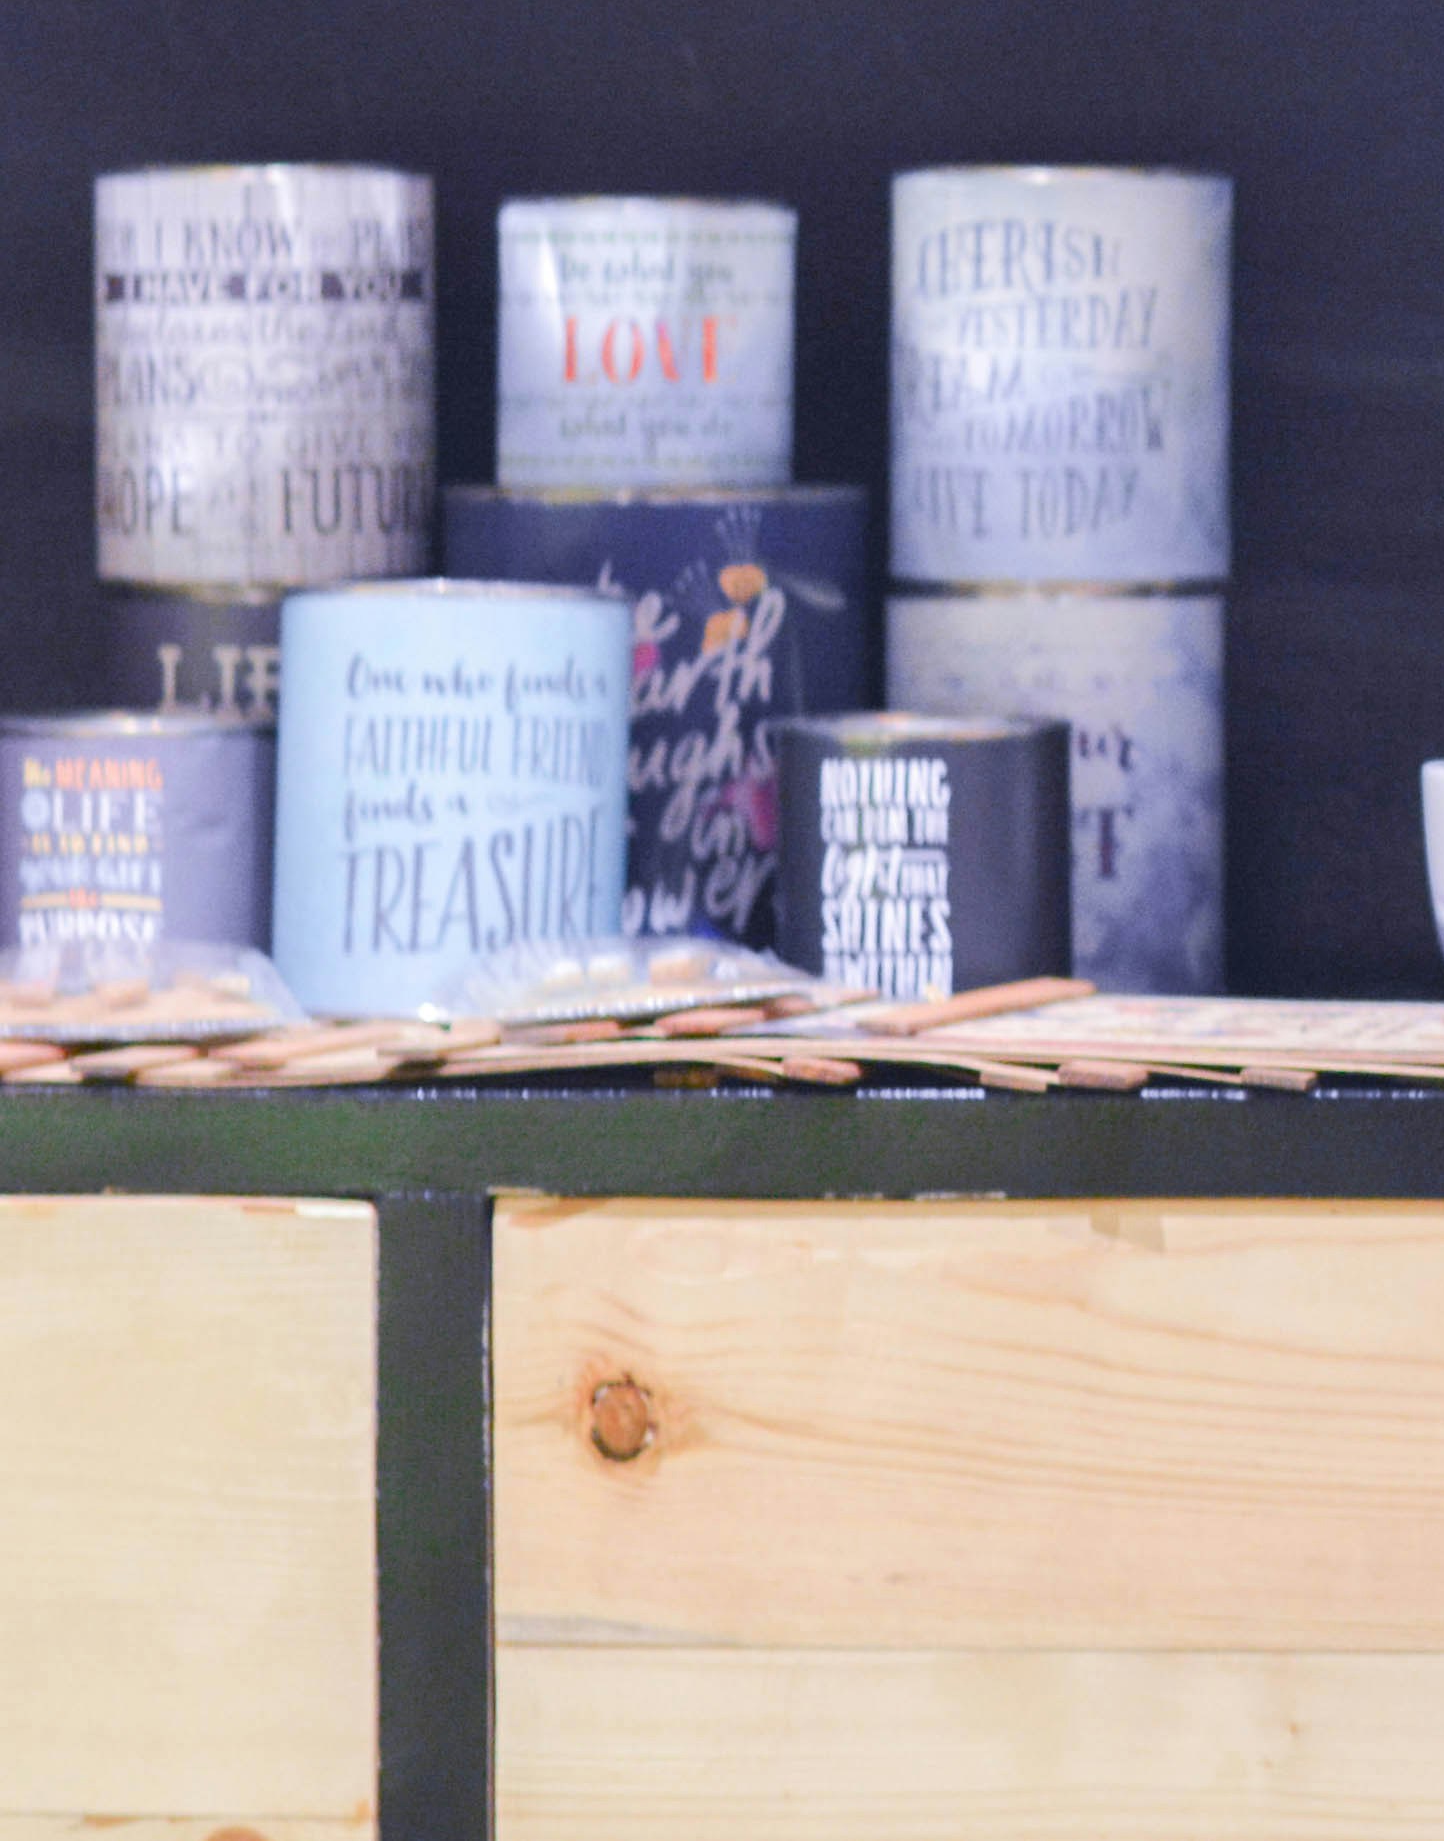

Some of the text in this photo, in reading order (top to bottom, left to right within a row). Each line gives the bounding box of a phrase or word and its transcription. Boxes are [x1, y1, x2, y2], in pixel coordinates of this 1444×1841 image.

[563, 313, 738, 384] LOVE
[344, 714, 492, 776] FAITHFUL
[339, 804, 607, 955] TREASURE
